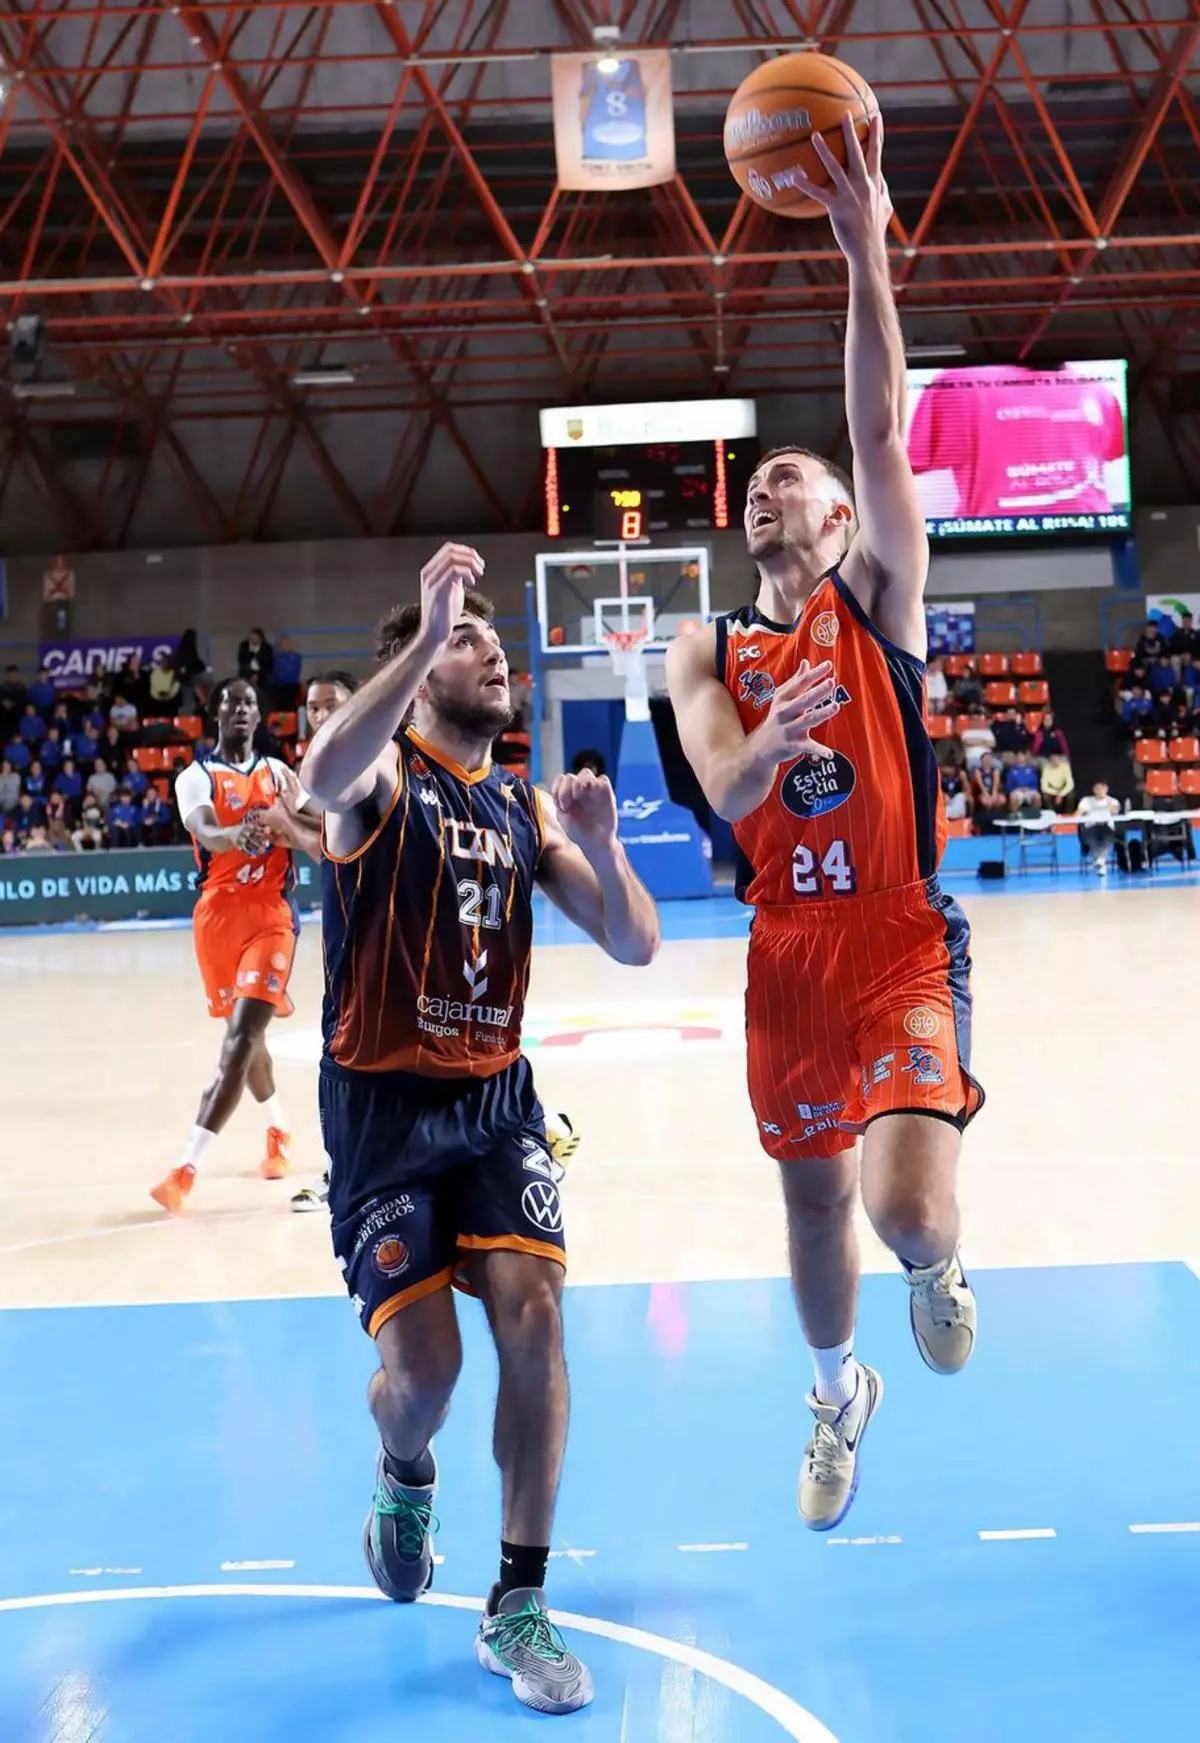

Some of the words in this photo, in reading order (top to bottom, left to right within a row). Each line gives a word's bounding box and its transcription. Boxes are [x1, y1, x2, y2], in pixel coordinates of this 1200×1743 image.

[606, 90, 627, 117] 8
[622, 511, 641, 539] 8
[1016, 517, 1040, 531] AL
[236, 863, 270, 885] 44
[793, 840, 854, 896] 24
[42, 878, 69, 898] DE
[75, 874, 129, 896] VIDA
[134, 868, 182, 893] MÁS
[457, 879, 502, 930] 21
[416, 1016, 460, 1038] Burgos
[361, 1202, 415, 1243] BURGOS
